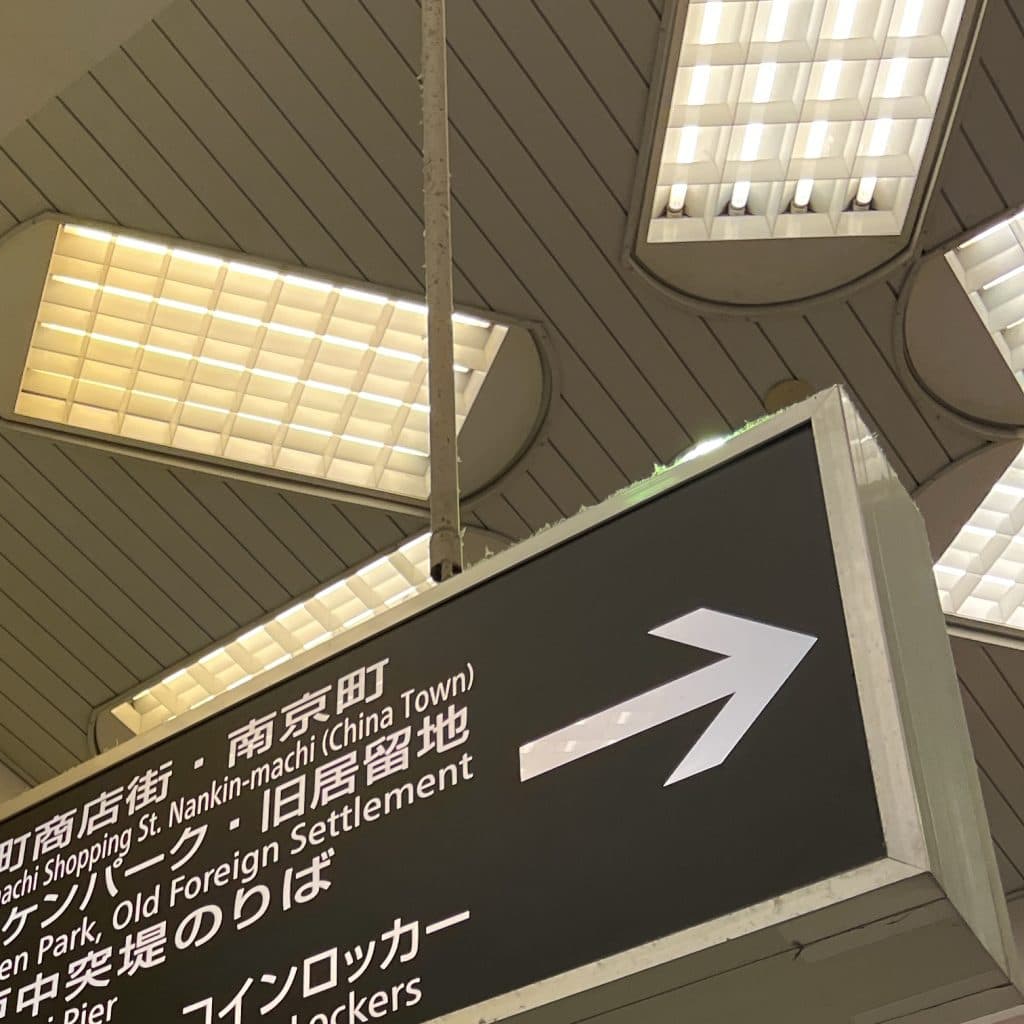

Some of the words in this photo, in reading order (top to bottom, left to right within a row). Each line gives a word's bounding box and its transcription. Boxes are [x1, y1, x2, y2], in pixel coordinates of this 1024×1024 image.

[38, 916, 102, 964] Park,
[112, 890, 160, 931] Old
[170, 842, 278, 906] Foreign
[291, 752, 474, 856] Settlement
[44, 826, 132, 888] Shopping
[138, 814, 161, 845] St.
[168, 742, 315, 830] Nankin-machi
[320, 706, 392, 760] (China
[401, 662, 474, 725] Town)
